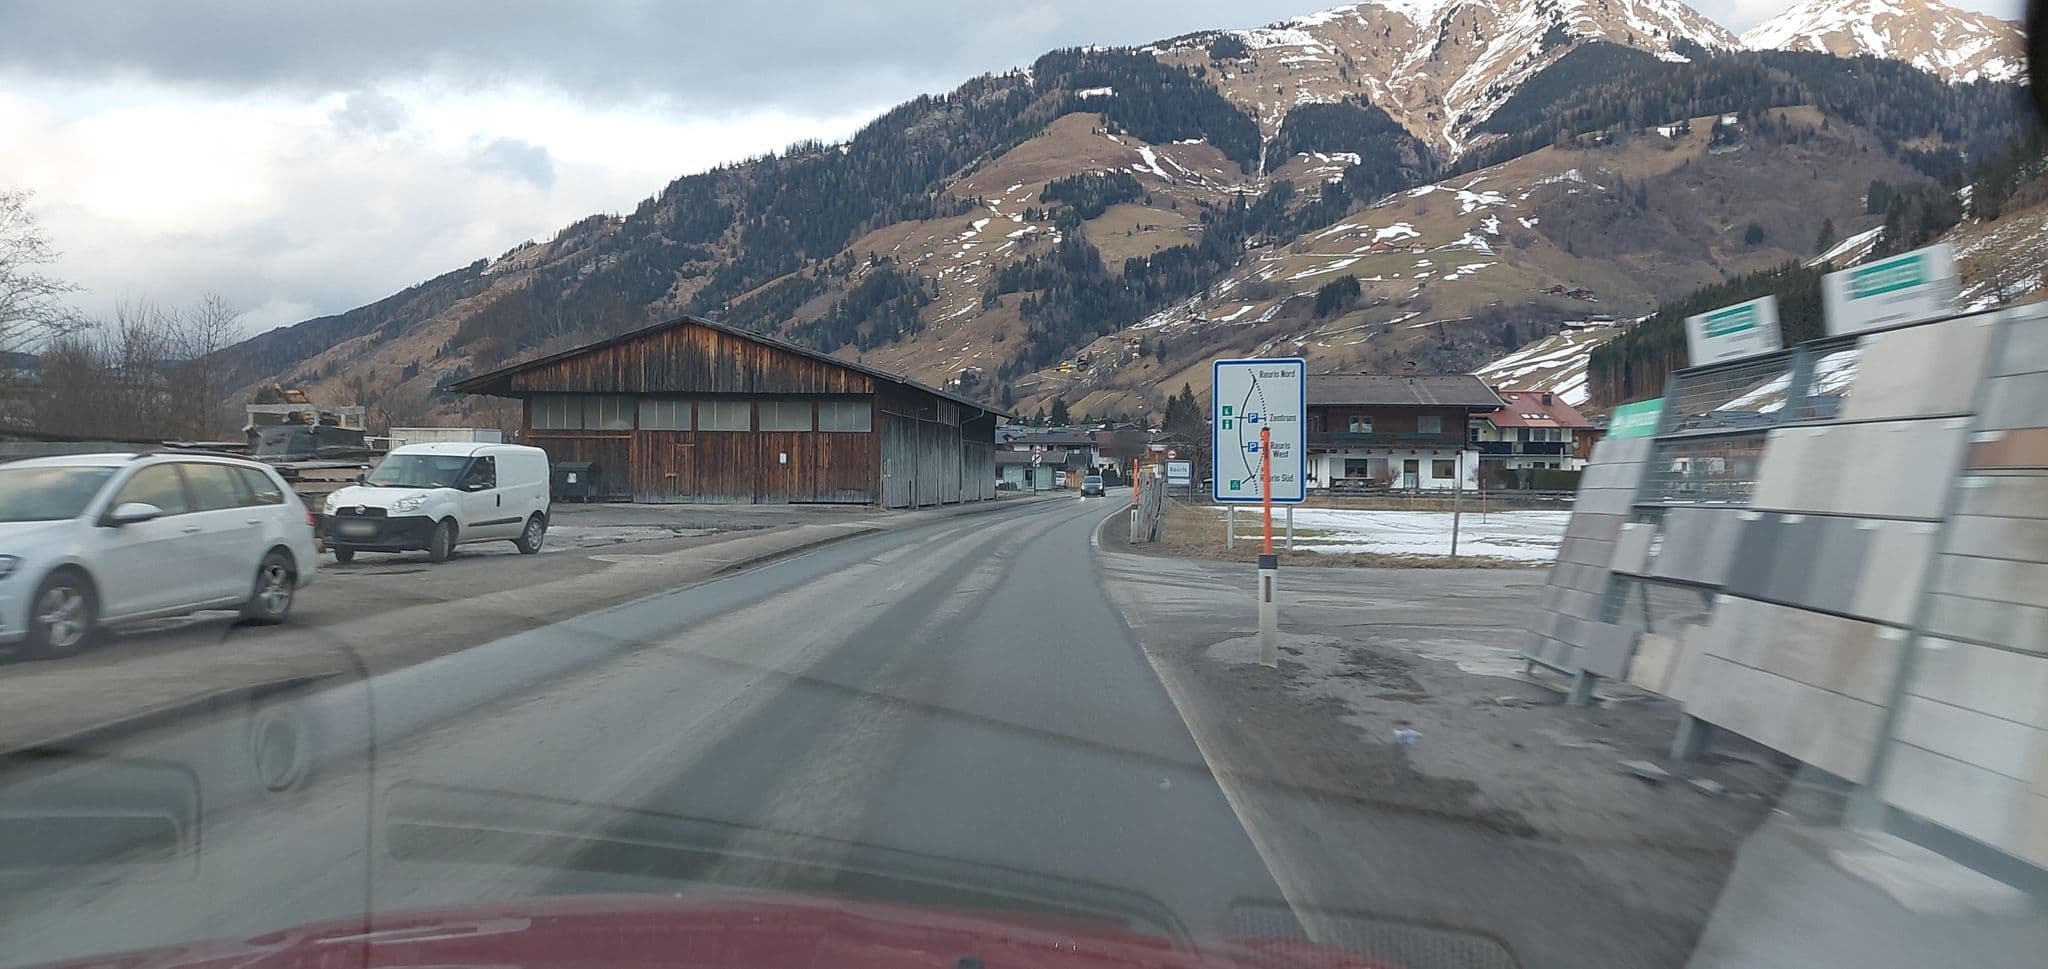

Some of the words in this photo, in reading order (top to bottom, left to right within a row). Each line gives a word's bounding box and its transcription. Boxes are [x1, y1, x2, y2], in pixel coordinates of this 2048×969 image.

[1259, 370, 1280, 379] Rauris
[1281, 370, 1296, 378] Nord
[1249, 413, 1257, 423] P
[1269, 414, 1297, 422] Zentrum
[1249, 442, 1257, 452] P
[1270, 442, 1291, 450] Rauris
[1273, 450, 1289, 459] West
[1259, 473, 1280, 482] Rris
